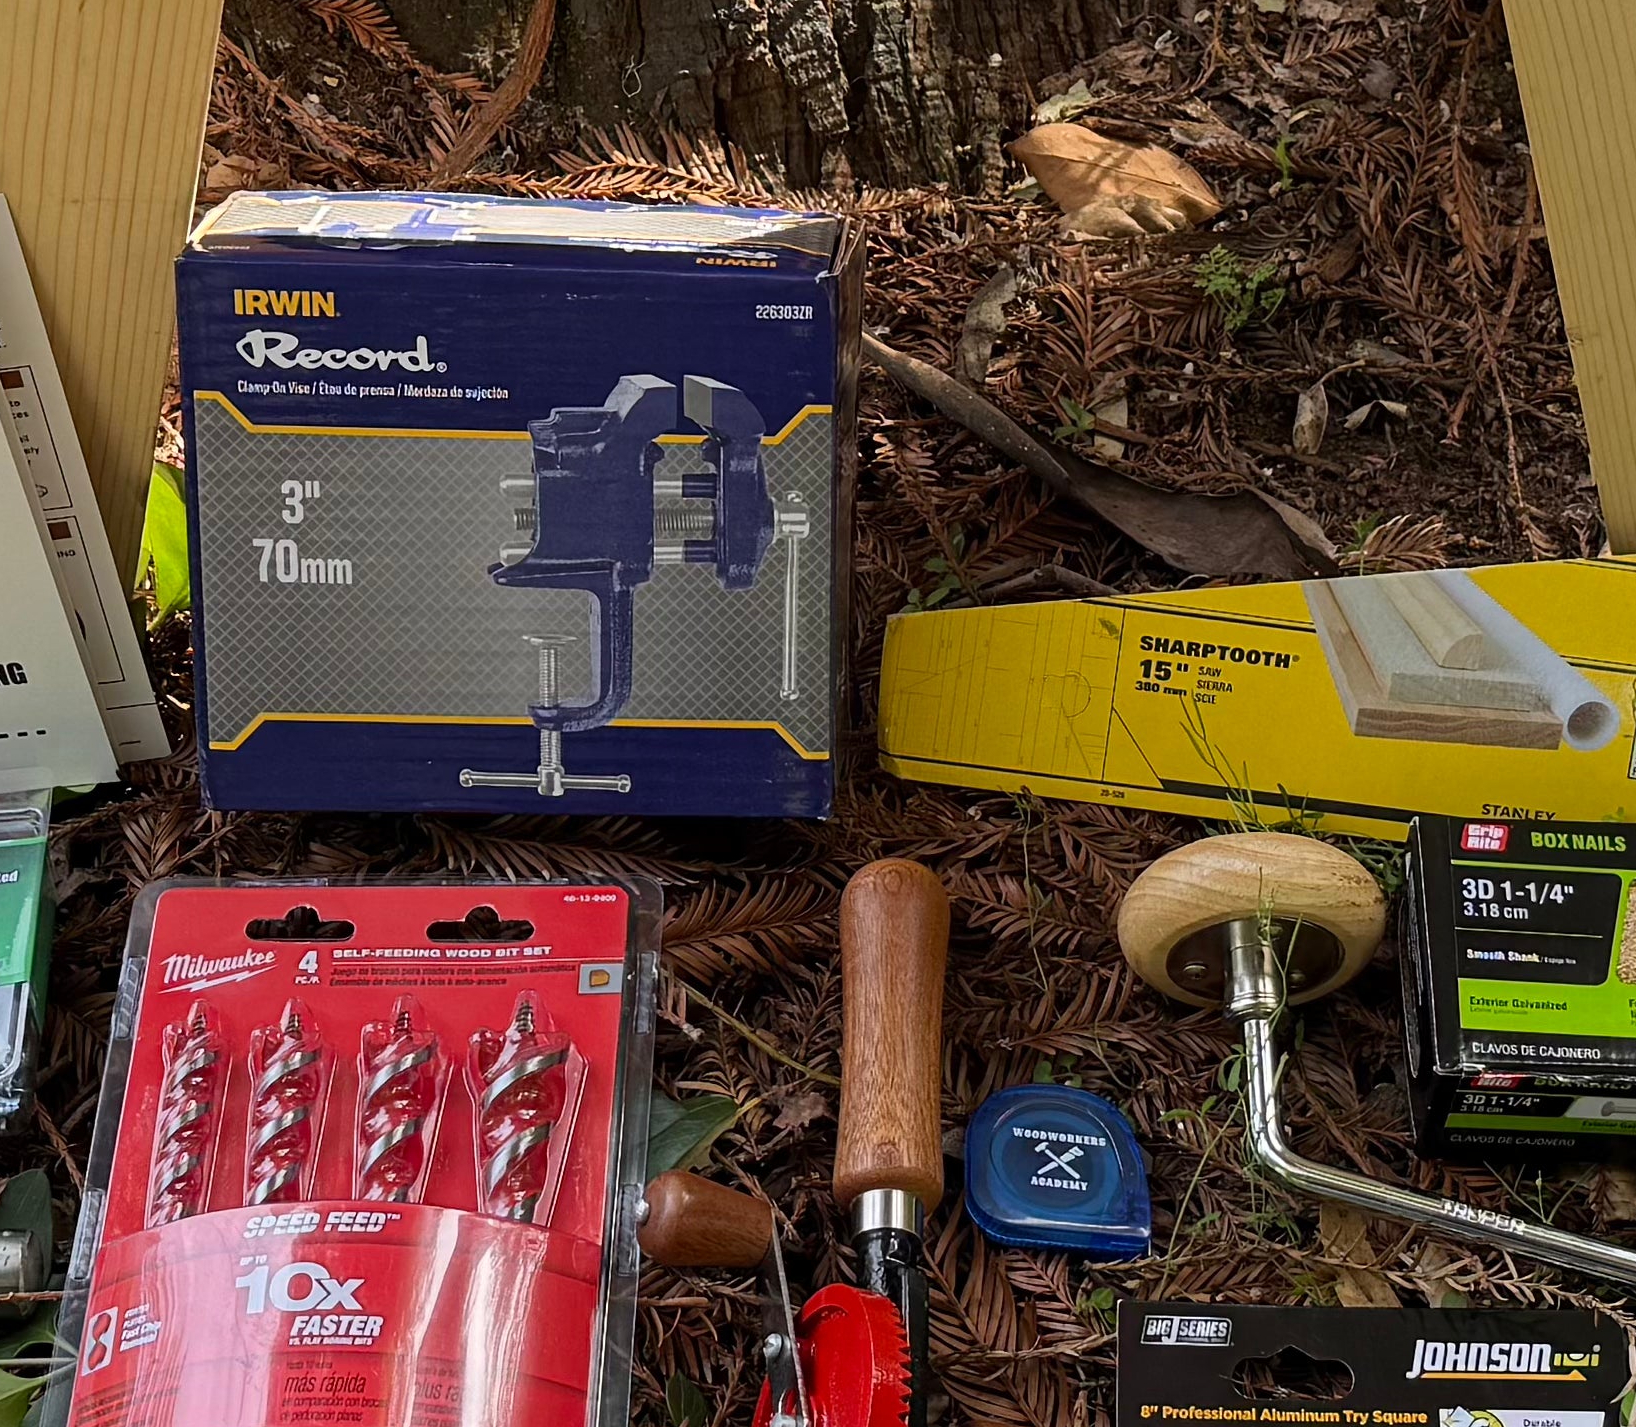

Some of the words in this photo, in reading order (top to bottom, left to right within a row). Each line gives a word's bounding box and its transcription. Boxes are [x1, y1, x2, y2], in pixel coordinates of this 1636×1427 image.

[233, 290, 335, 316] IRWIN
[755, 305, 813, 319] 226303ZR
[280, 479, 320, 525] 3"
[252, 538, 353, 585] 70mm
[1140, 636, 1291, 669] SHARPTOOTH
[1139, 659, 1189, 681] 15"
[1198, 666, 1222, 677] SAW
[1135, 680, 1160, 693] 380
[1196, 680, 1233, 693] SIERRA
[1194, 692, 1217, 704] SCIE
[1482, 804, 1555, 820] STANLEY
[1468, 824, 1504, 838] Grip
[1531, 832, 1569, 848] BOX
[1572, 835, 1626, 851] NAILS
[1463, 879, 1494, 900] 3D
[1501, 881, 1573, 904] 1-1/4"
[1463, 902, 1499, 916] 3.18
[1504, 907, 1528, 919] cm
[299, 951, 317, 973] 4
[333, 949, 441, 958] SELF-FEEDING
[445, 948, 491, 958] WOOD
[160, 949, 277, 985] Milwaukee
[1512, 998, 1567, 1011] Galvanized
[1472, 1042, 1517, 1056] CLAVOS
[1521, 1044, 1536, 1056] DE
[1539, 1046, 1601, 1060] CAJONERO
[1013, 1127, 1106, 1147] WOODWORKERS
[1031, 1176, 1088, 1191] ACADEMY
[243, 1213, 320, 1238] SPEED
[236, 1262, 365, 1314] 10x
[290, 1315, 383, 1336] FASTER
[1406, 1340, 1552, 1379] JOHNSON
[284, 1372, 316, 1393] más
[320, 1372, 366, 1395] rápida
[1162, 1406, 1256, 1422] Professional
[1260, 1407, 1339, 1422] Aluminum
[1343, 1409, 1369, 1425] Try
[1372, 1410, 1427, 1426] Square
